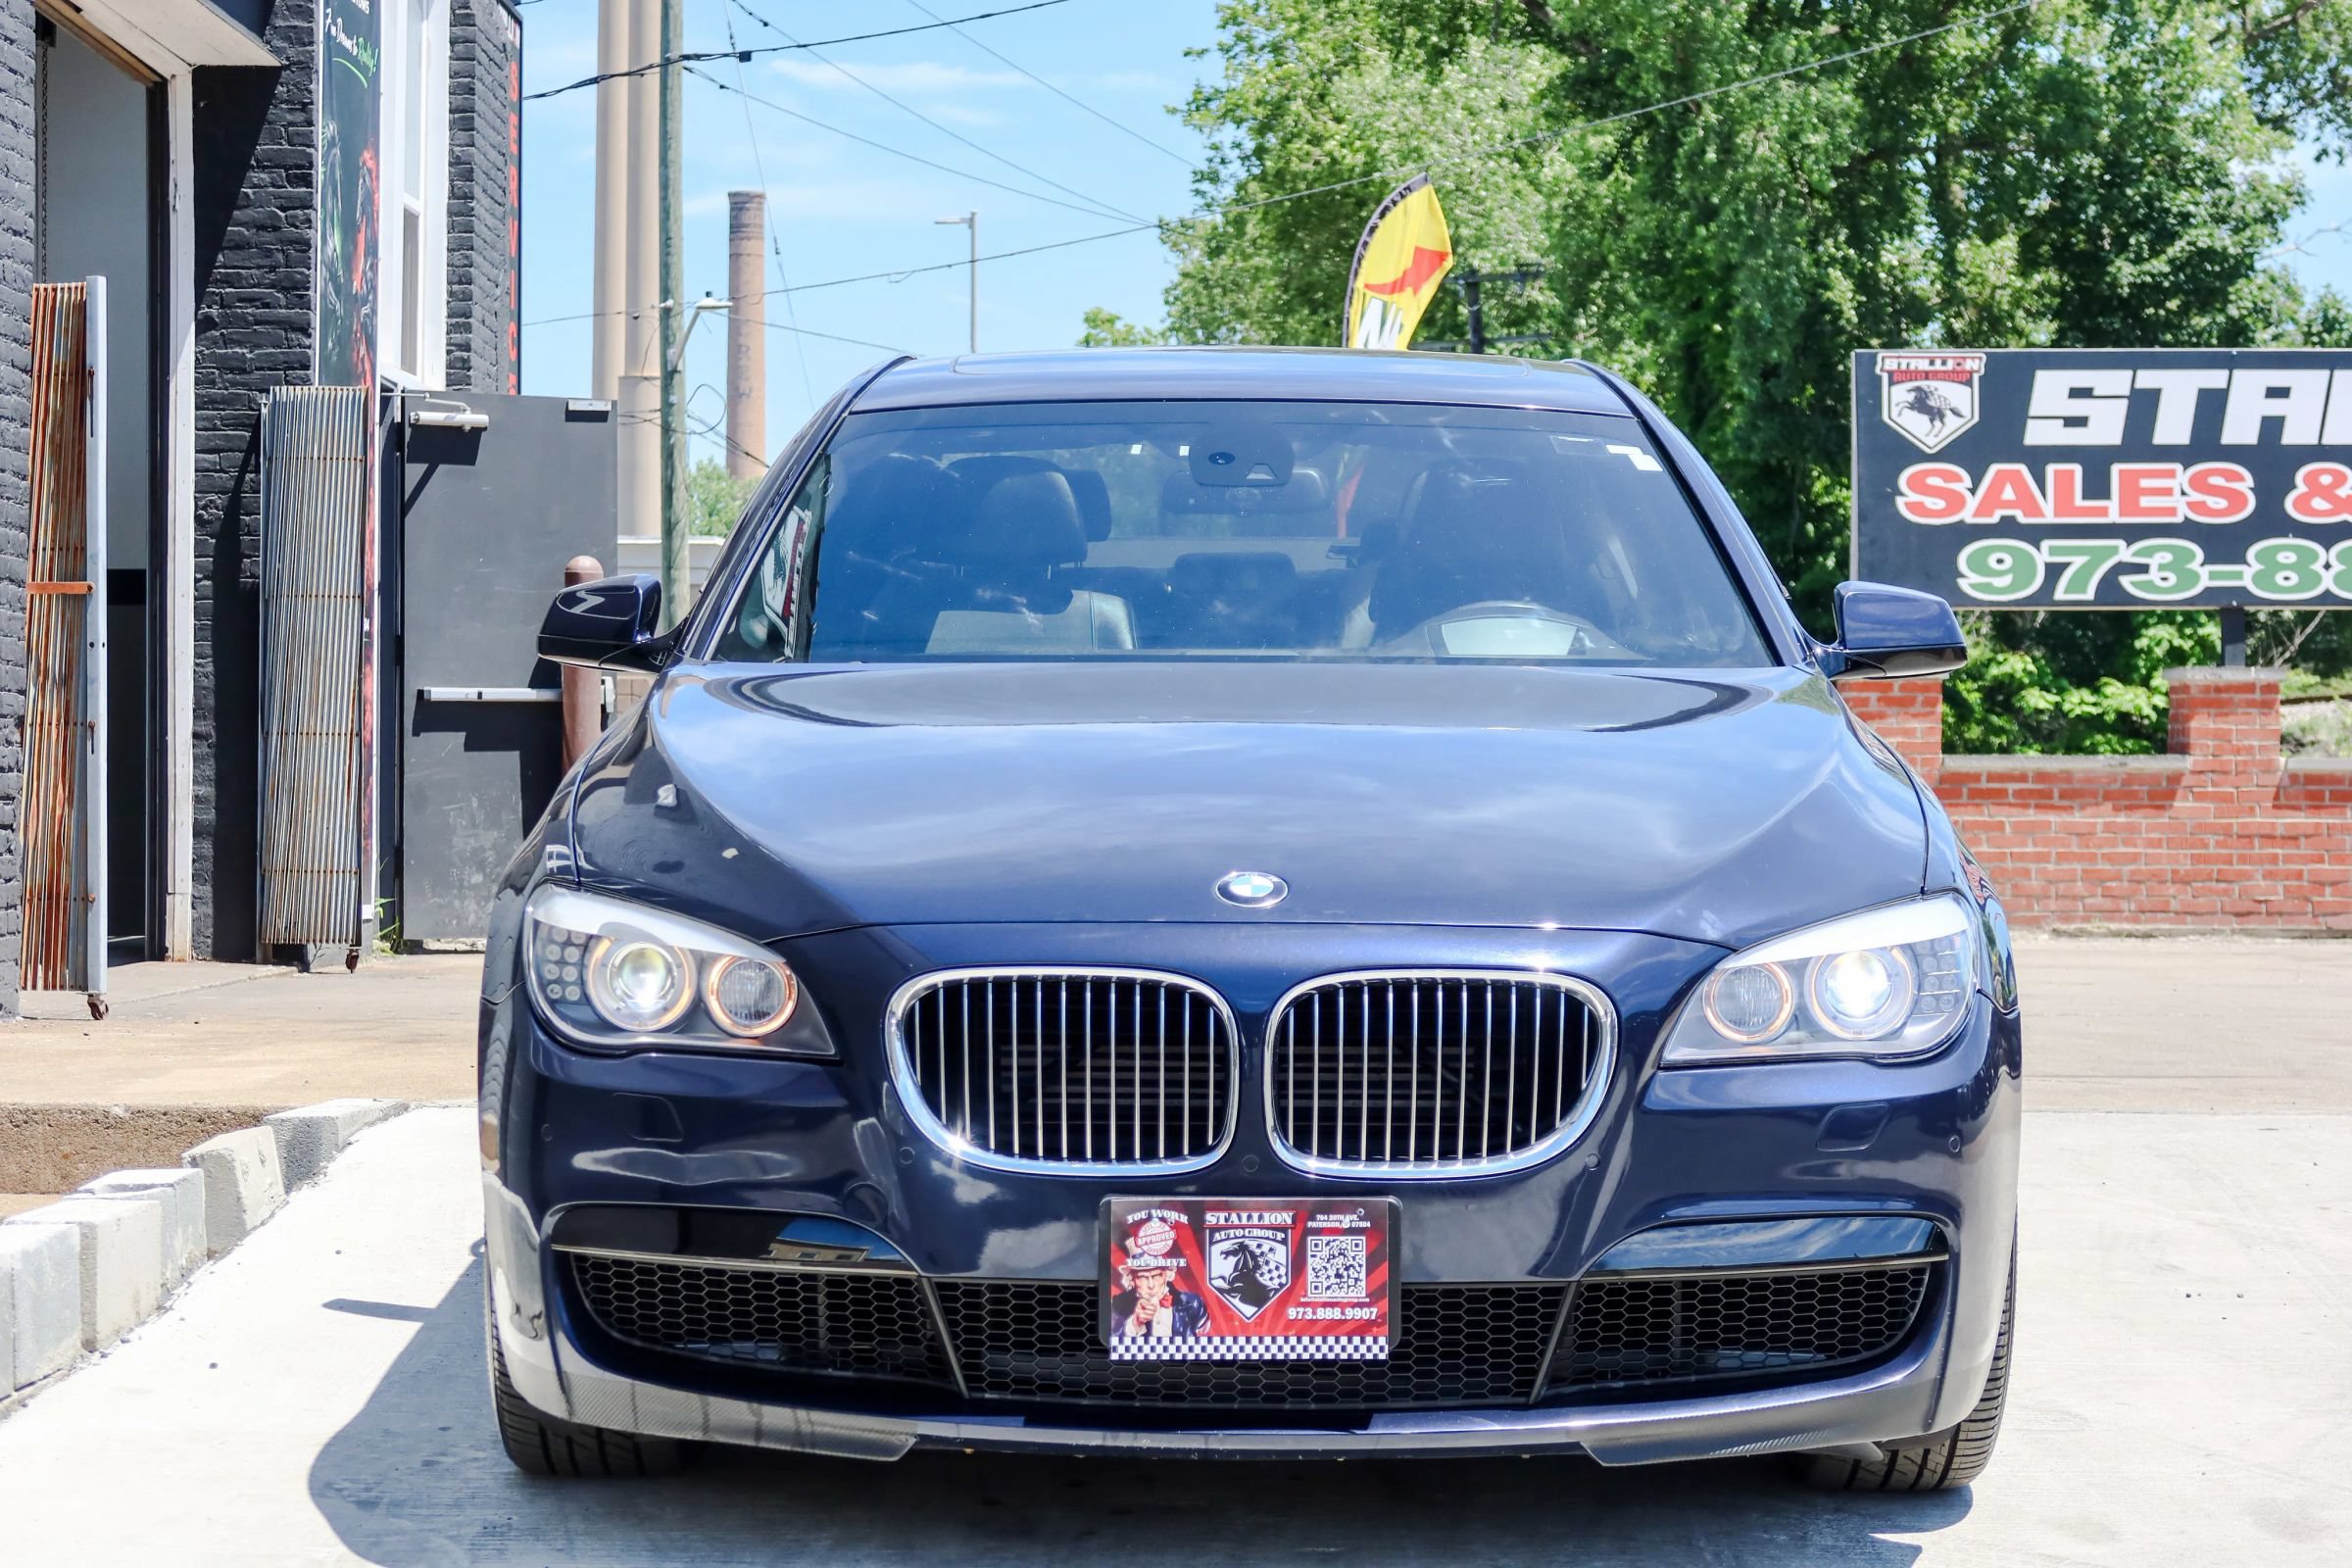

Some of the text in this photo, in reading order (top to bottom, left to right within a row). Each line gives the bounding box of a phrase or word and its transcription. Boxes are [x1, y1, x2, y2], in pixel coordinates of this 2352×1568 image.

[1883, 357, 1981, 370] STALLION
[1893, 370, 1971, 382] AUTO GROUP
[1895, 461, 2352, 525] SALES &
[1127, 1209, 1189, 1224] YOU WORK
[1205, 1212, 1294, 1225] STALLION
[1138, 1231, 1175, 1246] APPROVED
[1212, 1228, 1286, 1242] AUTO GROUP
[1127, 1258, 1187, 1267] YOU DRIVE
[1288, 1306, 1378, 1321] 973.888.9907
